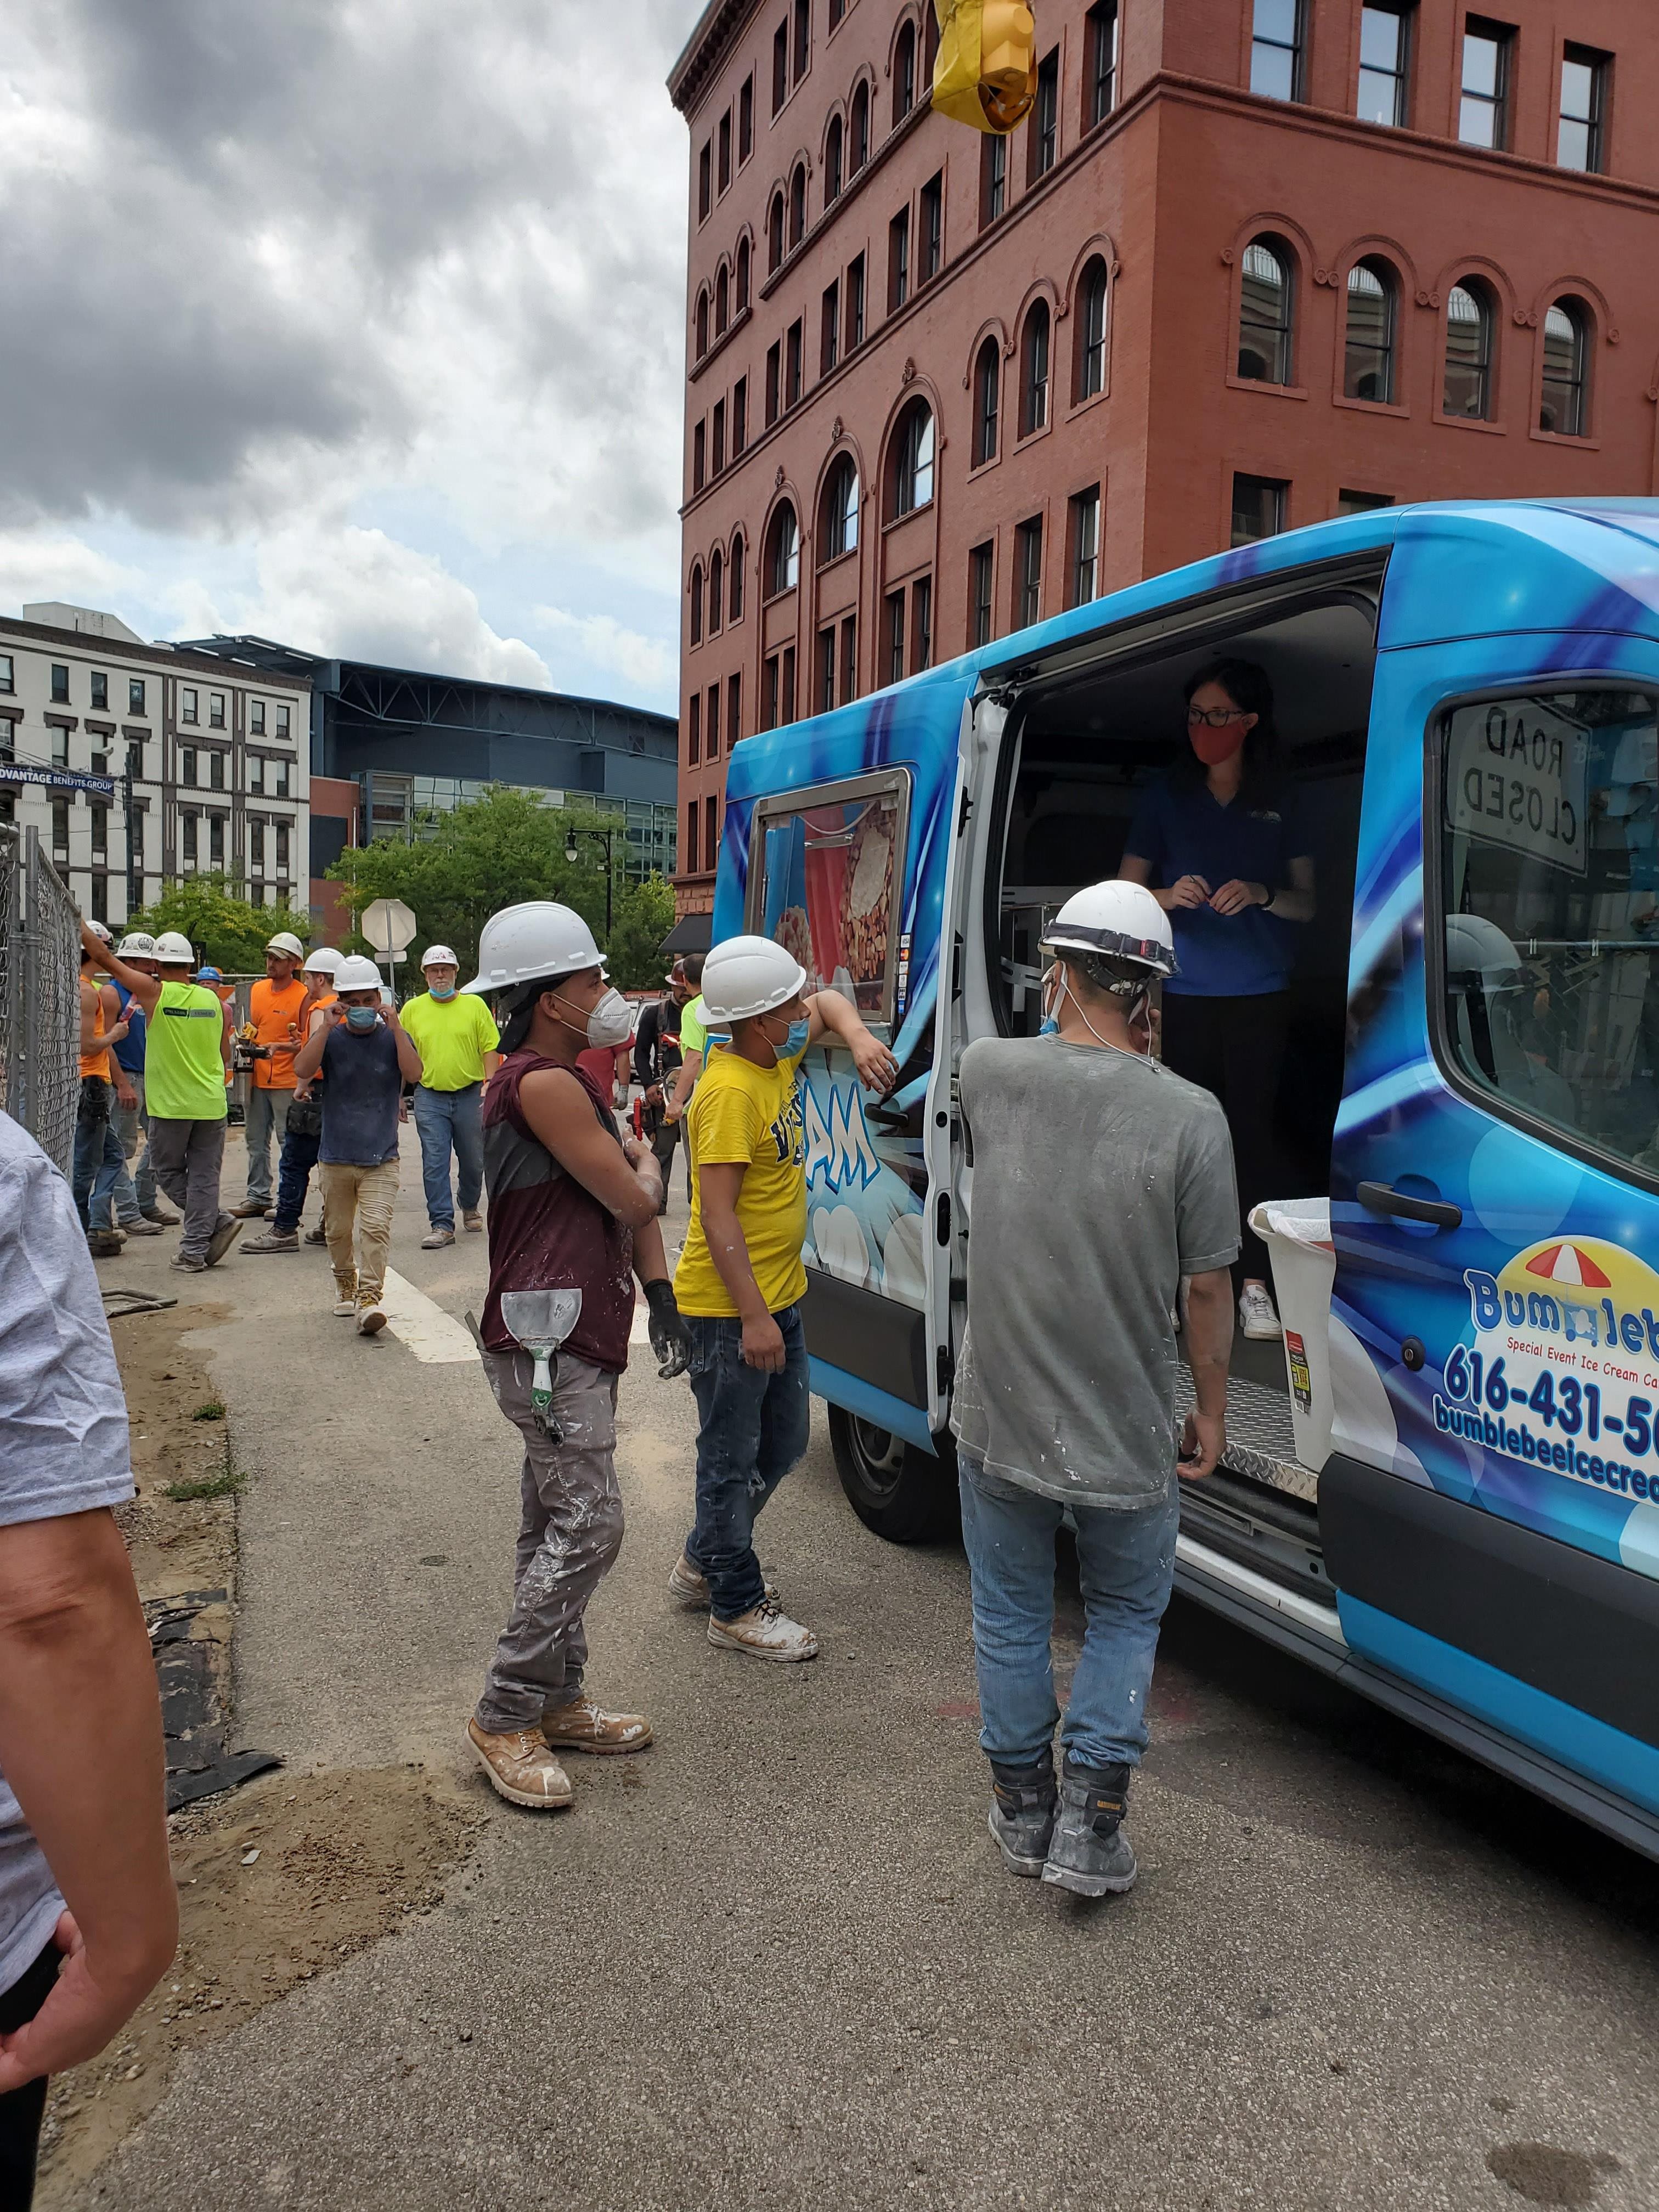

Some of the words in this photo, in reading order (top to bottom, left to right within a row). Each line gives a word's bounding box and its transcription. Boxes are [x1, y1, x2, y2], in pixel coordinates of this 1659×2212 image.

[53, 776, 86, 787] BENEFITS
[87, 780, 112, 791] GROUP
[1506, 1336, 1543, 1357] Special
[1547, 1347, 1577, 1366] Event
[1581, 1355, 1599, 1372] Ice
[1603, 1362, 1639, 1384] Cream
[1643, 1373, 1659, 1390] Ca
